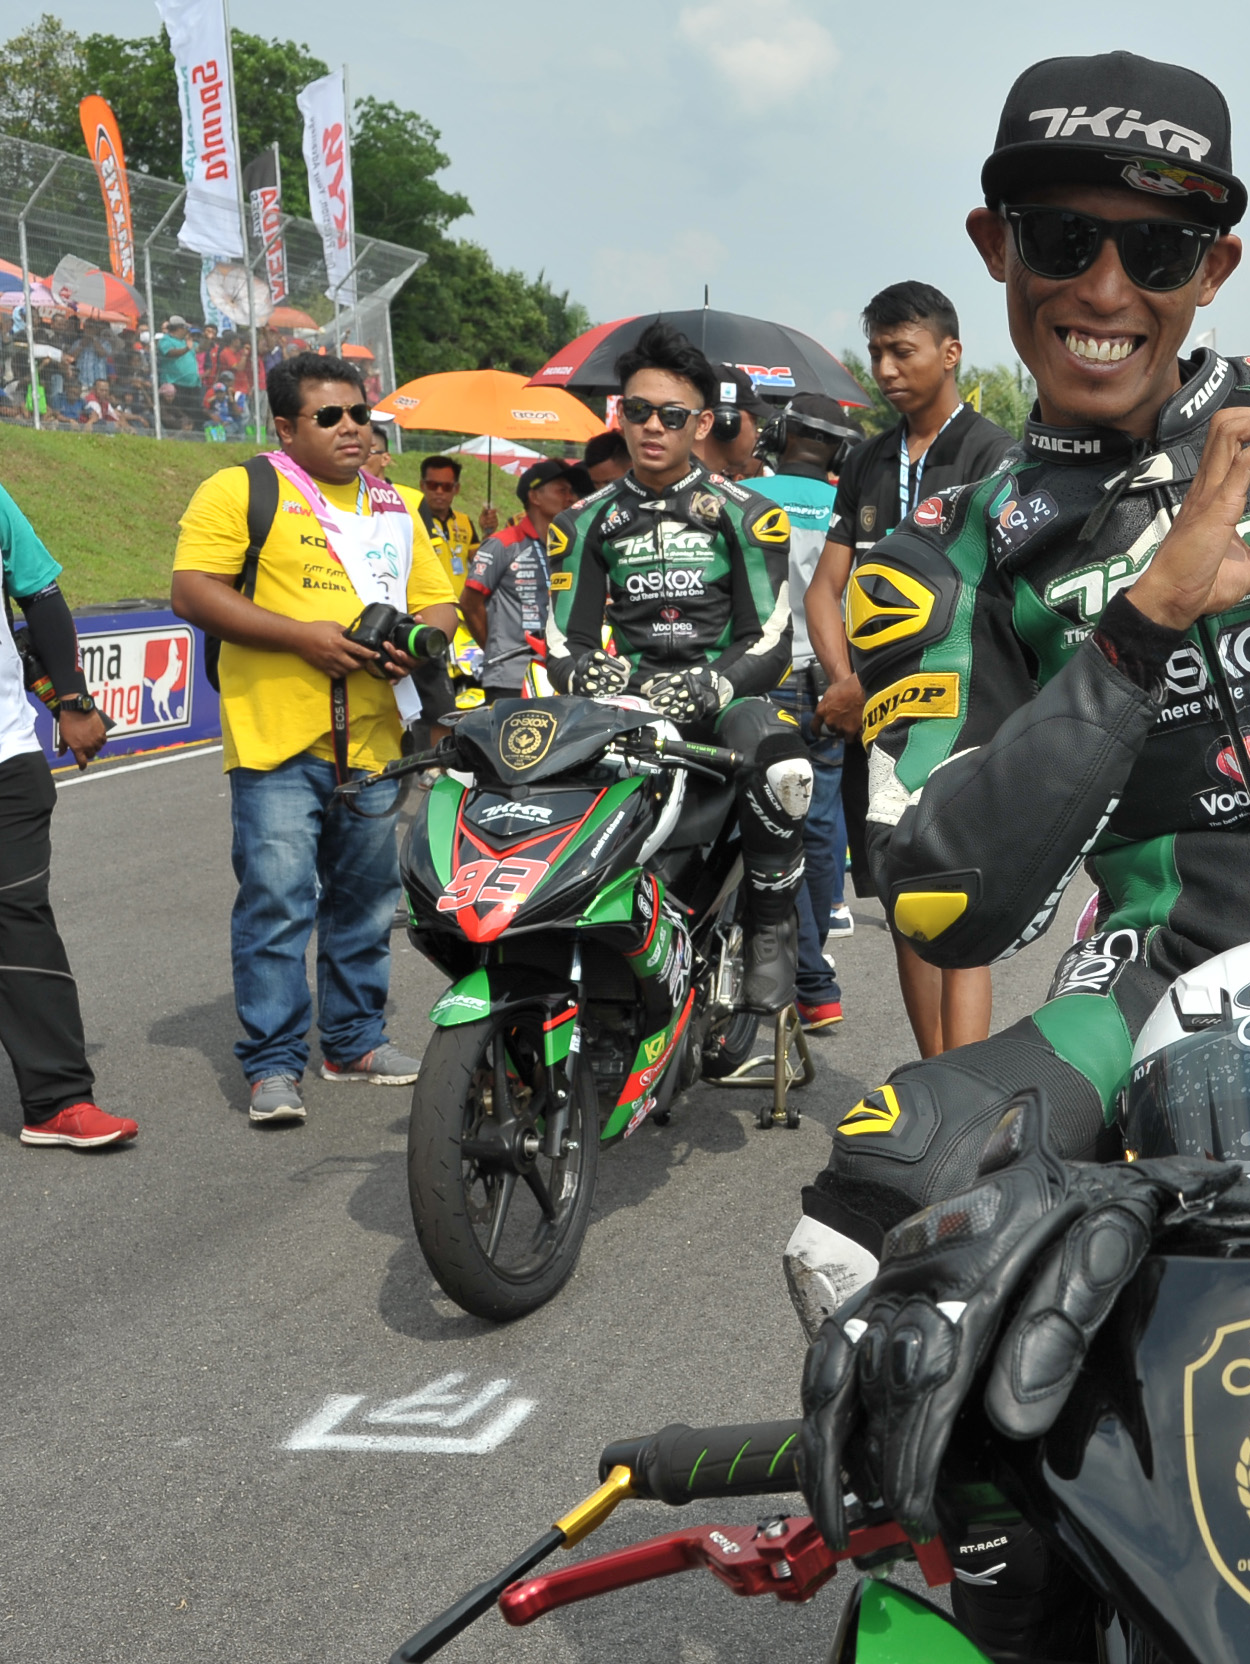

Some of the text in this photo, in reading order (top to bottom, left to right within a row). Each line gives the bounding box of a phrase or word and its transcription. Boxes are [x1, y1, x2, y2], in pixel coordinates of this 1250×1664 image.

[1179, 357, 1229, 420] TAICHI
[1028, 432, 1101, 455] TAICHI
[370, 487, 401, 505] 002
[81, 643, 122, 683] ma
[335, 706, 346, 730] EOS
[436, 857, 550, 913] 93
[959, 1535, 1009, 1556] RT-RACE
